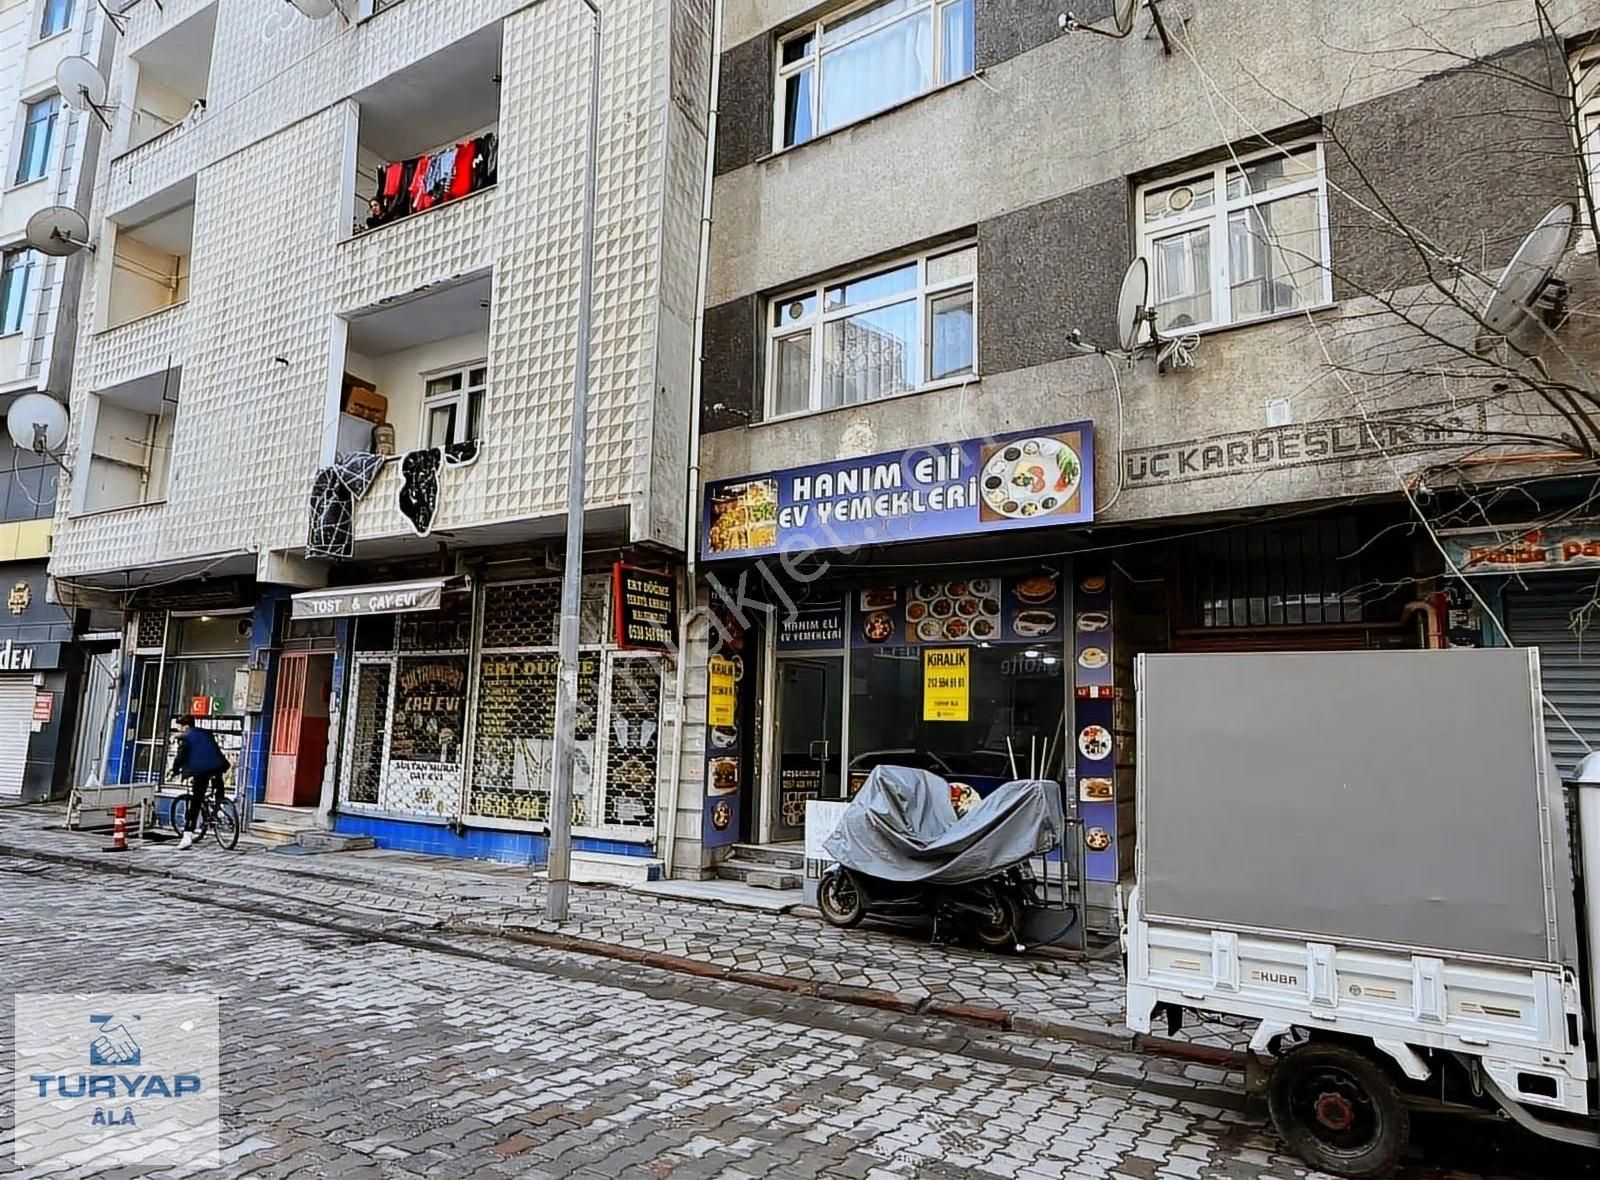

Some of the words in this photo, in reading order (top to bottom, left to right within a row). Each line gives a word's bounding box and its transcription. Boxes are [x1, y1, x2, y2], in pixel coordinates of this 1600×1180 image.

[793, 462, 901, 502] HANIM
[778, 505, 808, 528] EV
[816, 477, 977, 525] YEMEKLERİ
[312, 600, 341, 612] TOST
[351, 597, 360, 610] &
[1260, 971, 1297, 985] KUBA
